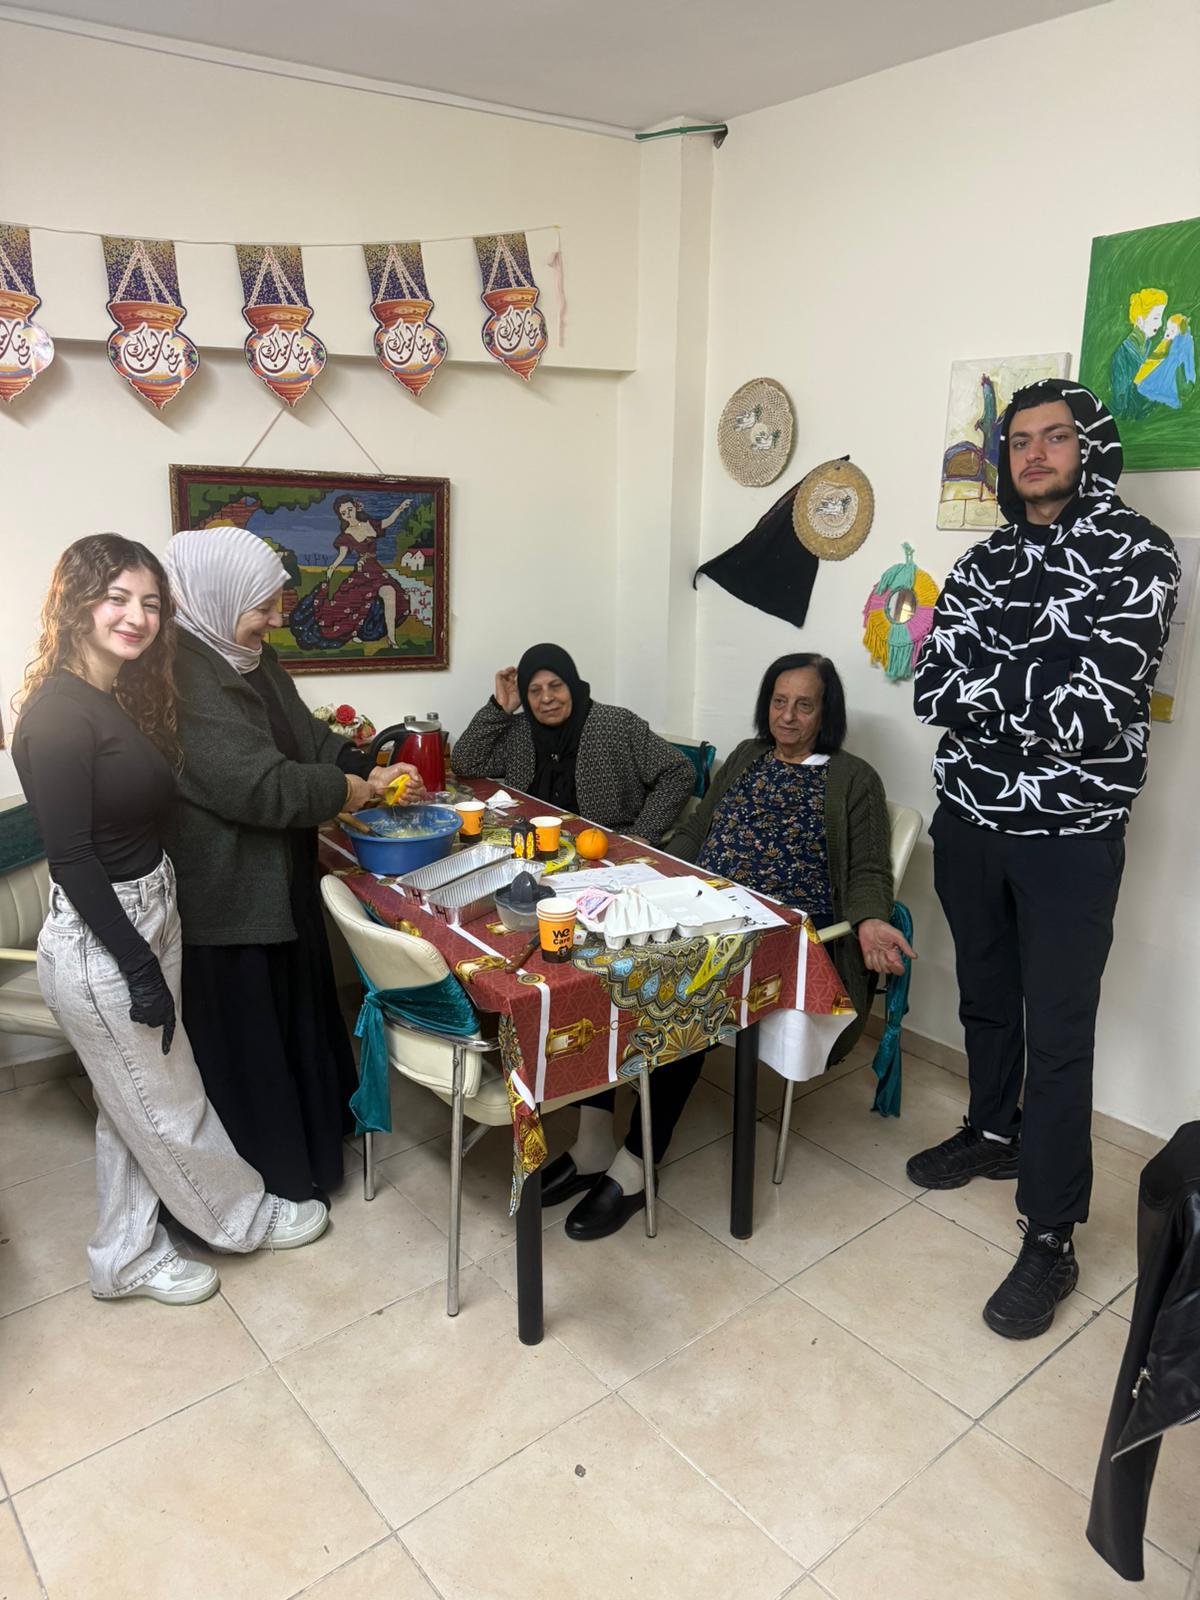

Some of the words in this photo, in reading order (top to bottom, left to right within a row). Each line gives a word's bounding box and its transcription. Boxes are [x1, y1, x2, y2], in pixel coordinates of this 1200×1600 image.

[387, 321, 413, 354] مبارك
[497, 309, 539, 352] رمضان
[499, 307, 523, 341] مبارك
[124, 331, 182, 373] رمضان
[126, 326, 159, 362] مبارك
[258, 331, 311, 373] رمضان
[260, 327, 289, 362] مبارك
[386, 323, 433, 365] رمضان
